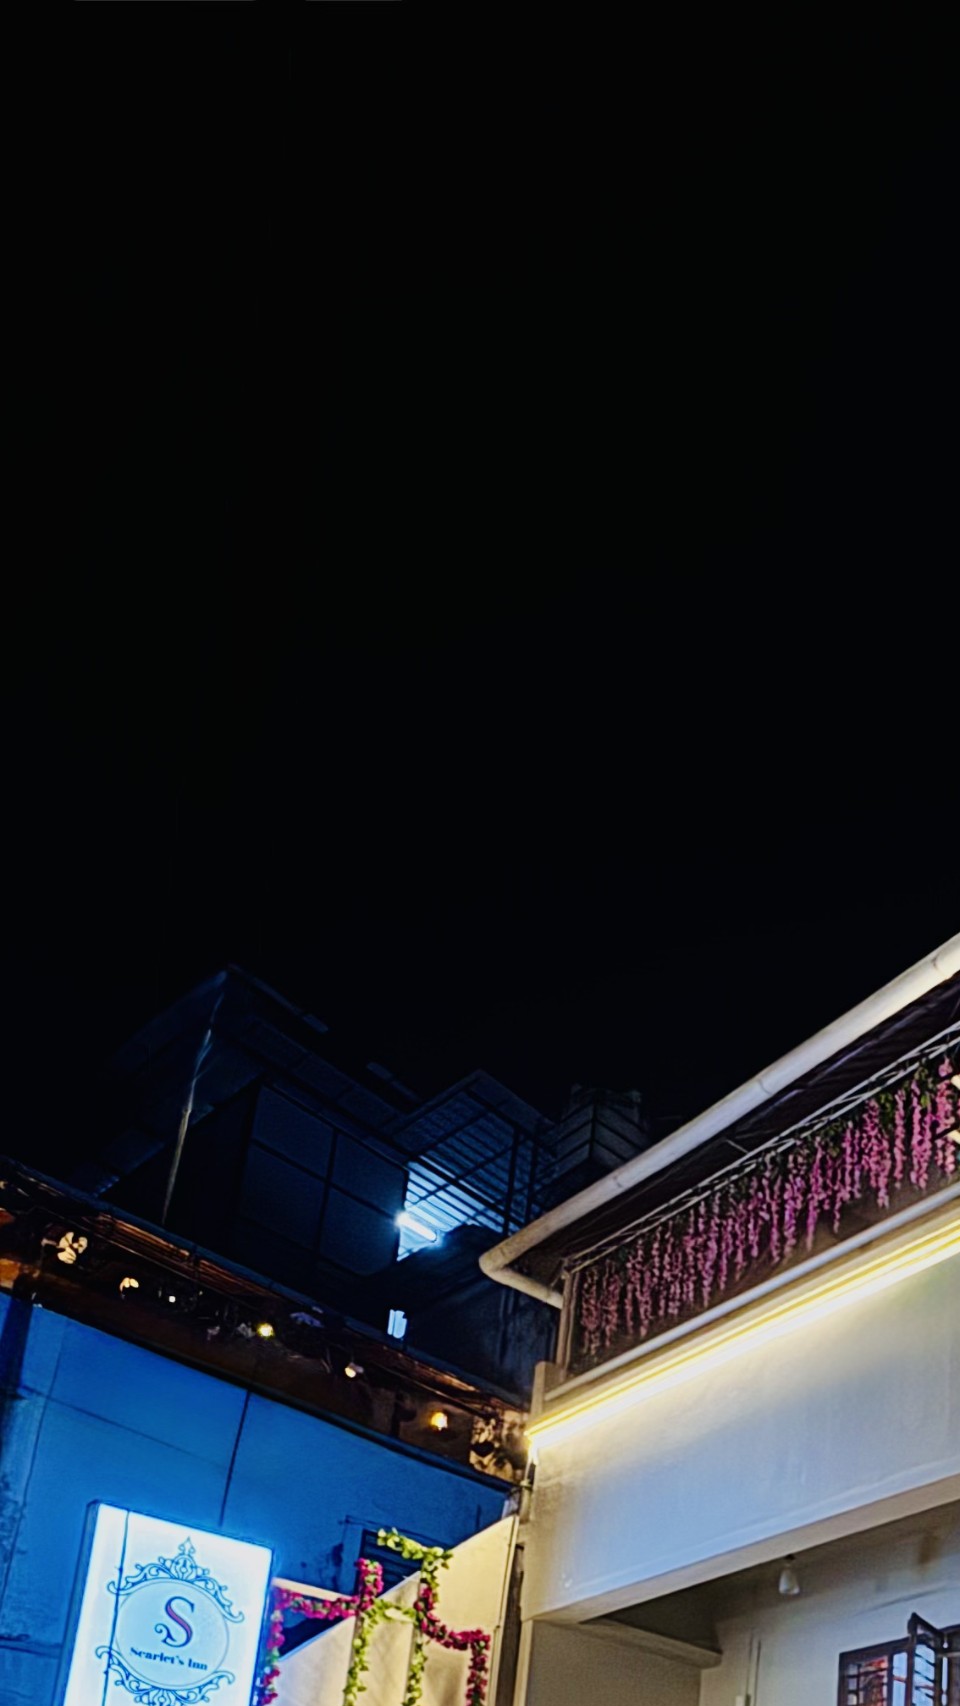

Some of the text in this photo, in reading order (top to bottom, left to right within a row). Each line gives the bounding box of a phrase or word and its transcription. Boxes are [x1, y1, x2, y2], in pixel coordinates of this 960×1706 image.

[154, 1595, 195, 1648] S
[130, 1647, 208, 1671] Scarlet's Inn
